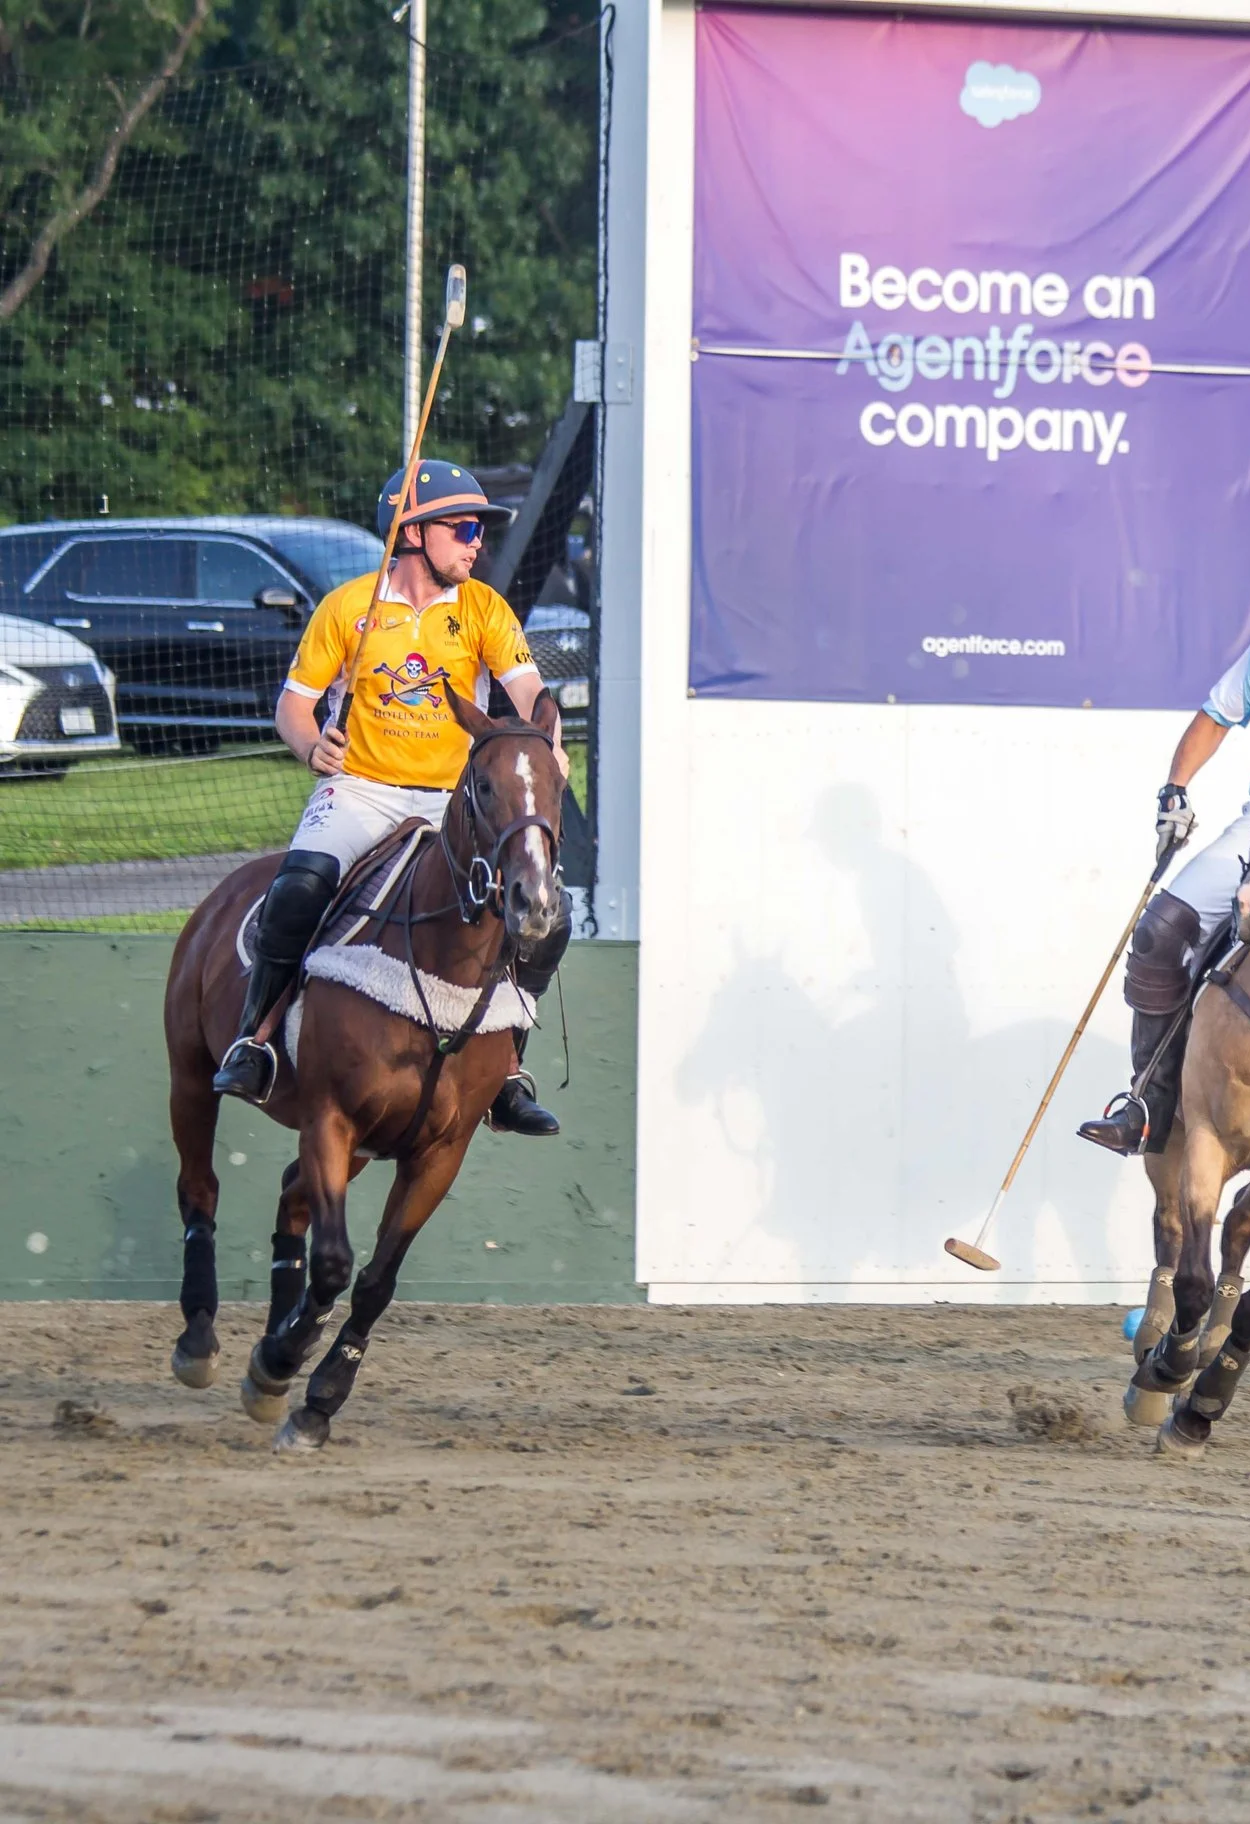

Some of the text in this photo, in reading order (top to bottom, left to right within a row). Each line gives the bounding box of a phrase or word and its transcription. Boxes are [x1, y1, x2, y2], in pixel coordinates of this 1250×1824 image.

[840, 252, 1155, 320] Become an
[836, 320, 1152, 399] Agentforce
[860, 401, 1130, 465] company.
[922, 634, 1066, 658] agentforce.com
[383, 728, 440, 740] POLO TEAM
